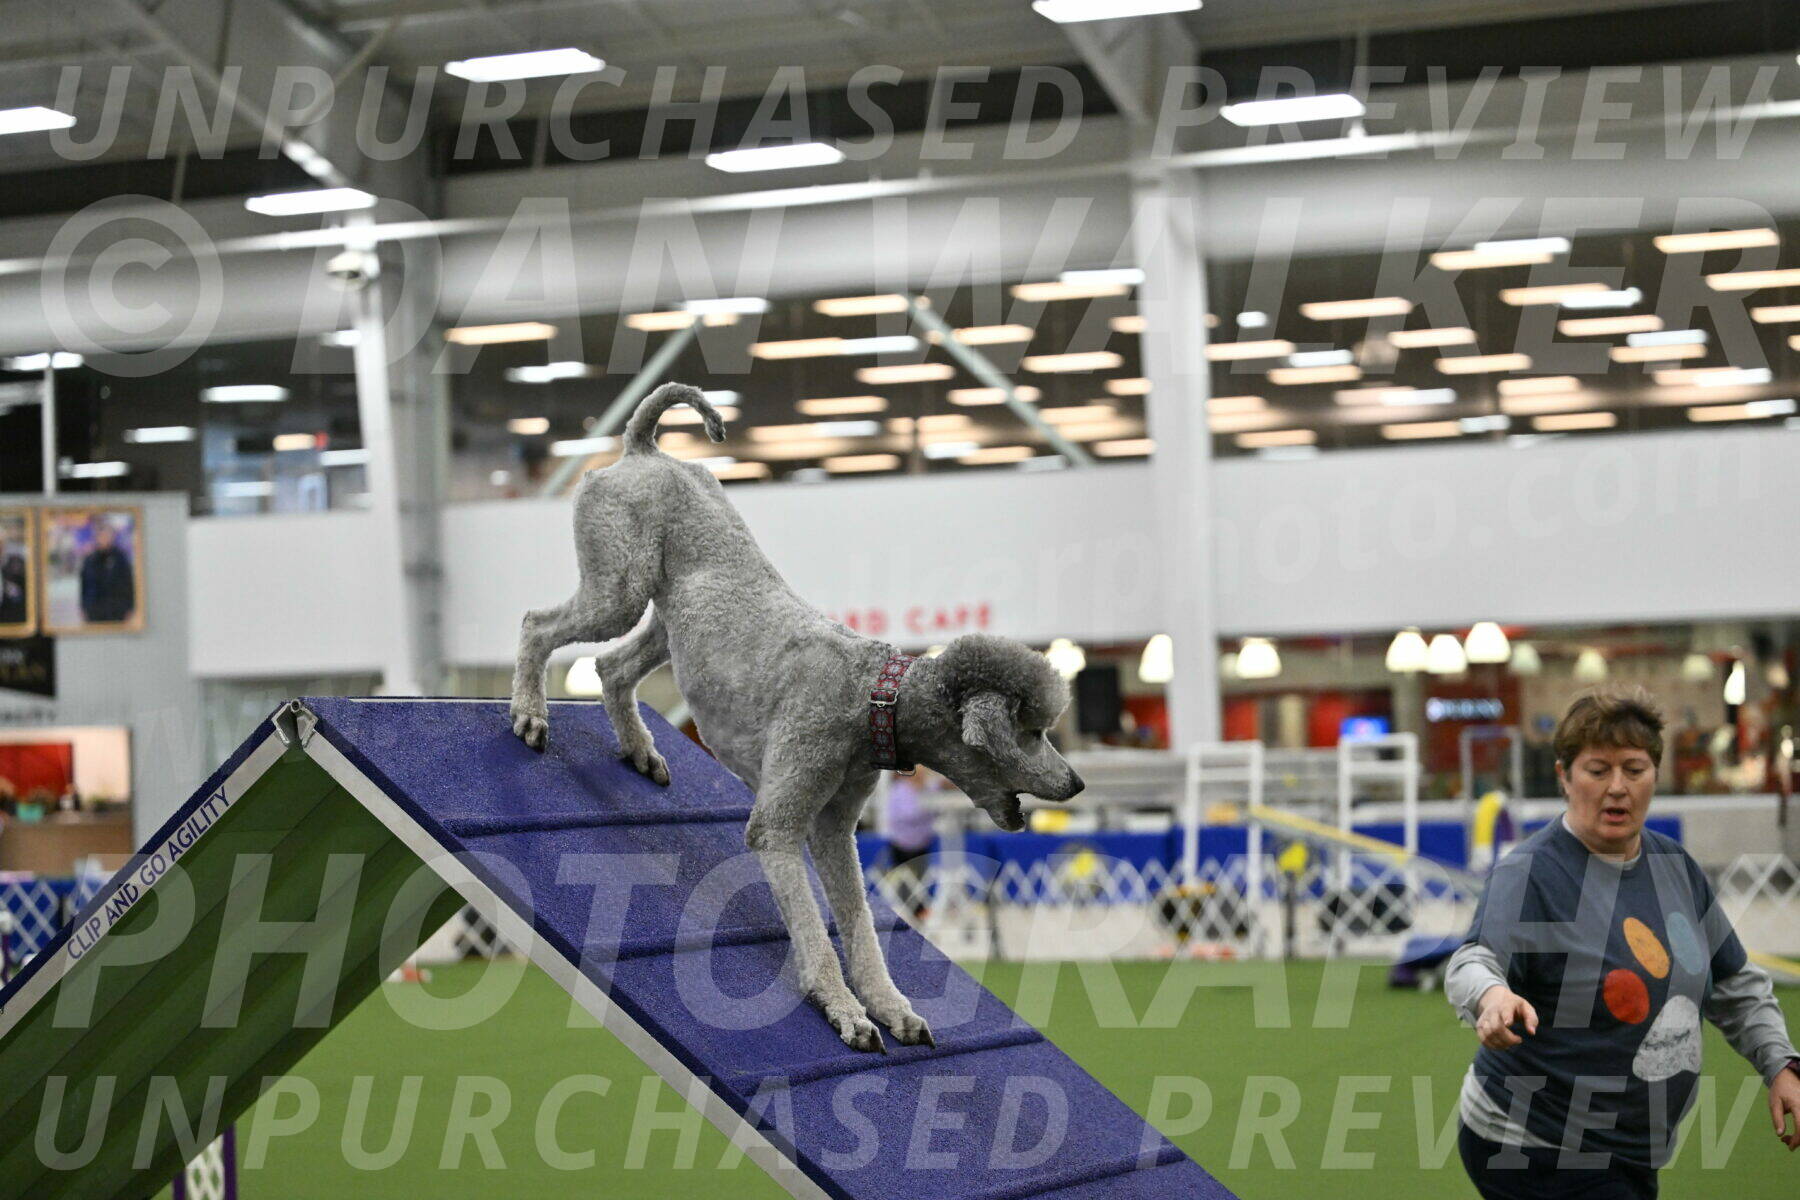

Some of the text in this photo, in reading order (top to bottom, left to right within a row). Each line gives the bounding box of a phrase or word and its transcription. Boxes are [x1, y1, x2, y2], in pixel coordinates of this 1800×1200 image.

[67, 785, 231, 959] CLIP AND GO AGILITY
